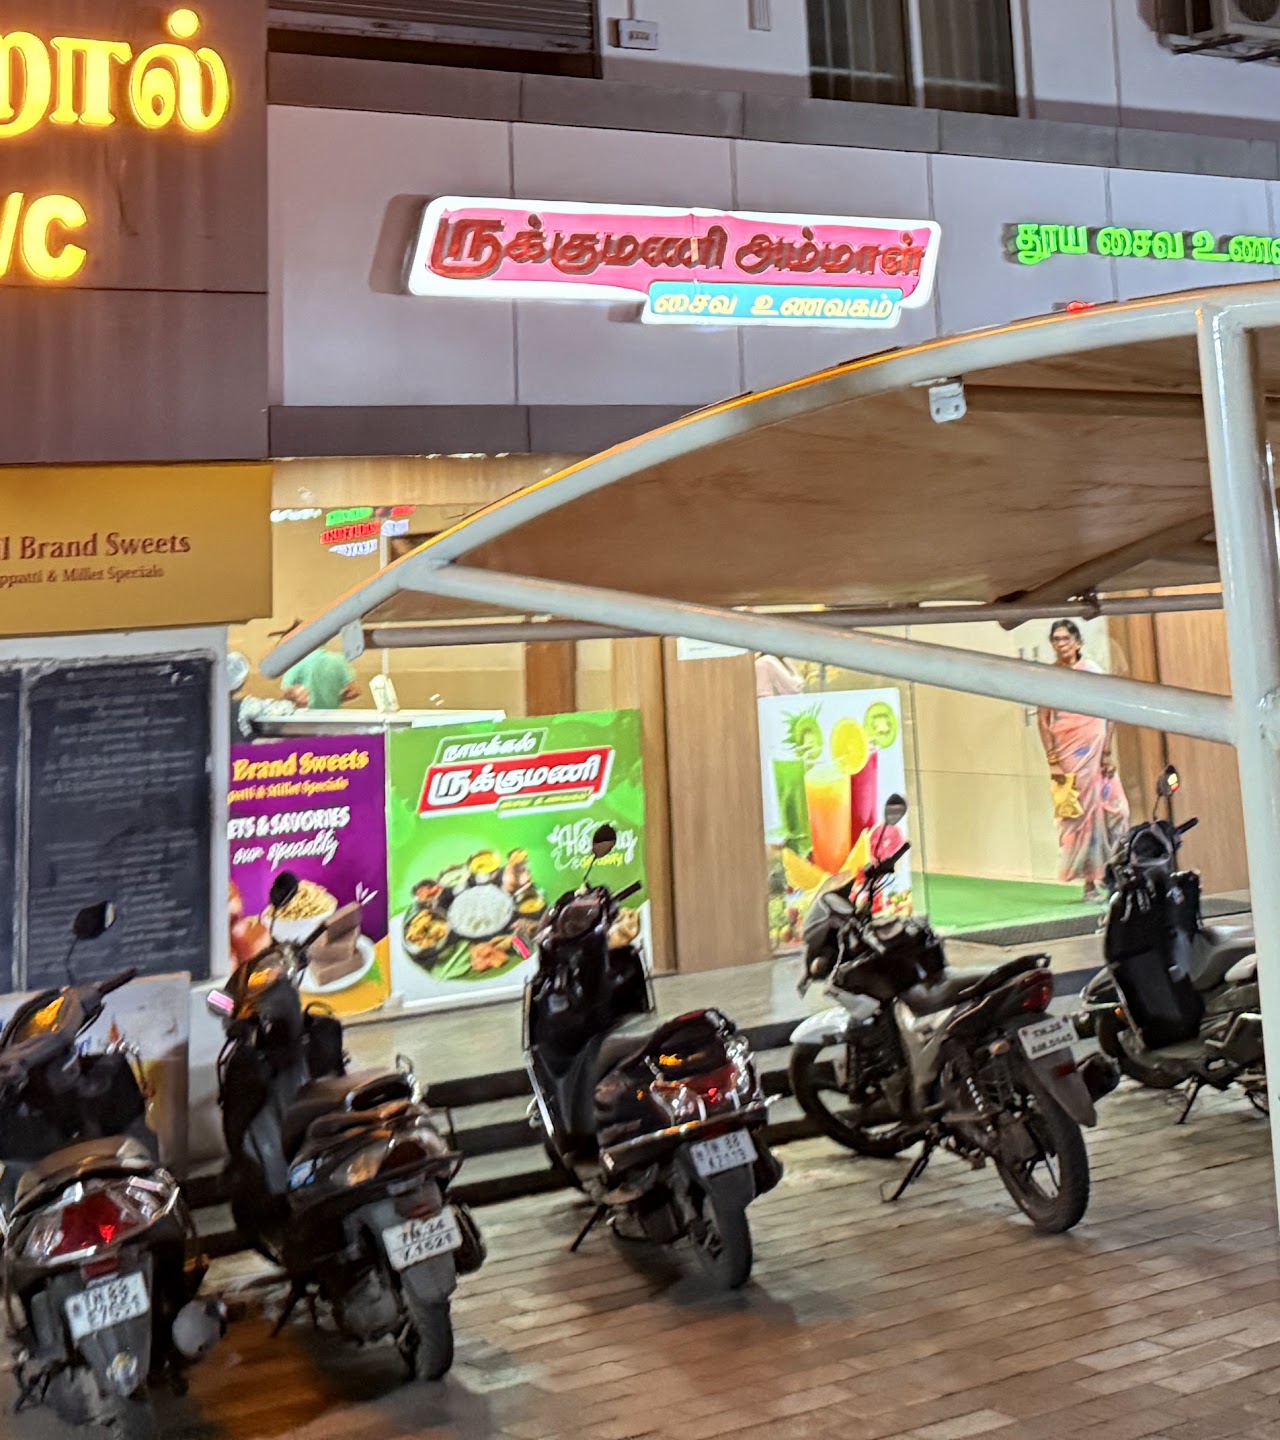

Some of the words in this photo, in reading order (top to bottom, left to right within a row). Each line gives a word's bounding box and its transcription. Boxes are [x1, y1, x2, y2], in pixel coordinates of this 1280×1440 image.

[429, 211, 728, 280] ருக்குமணி
[735, 226, 926, 277] அம்மாள்
[1015, 223, 1088, 265] தூய
[1096, 226, 1185, 260] சைவ
[652, 293, 738, 316] சைவ
[750, 292, 896, 319] உணவகம்
[20, 532, 98, 560] Brand
[105, 531, 192, 557] Sweets
[47, 570, 58, 583] &
[107, 563, 165, 584] Specials
[441, 731, 537, 763] நாமக்கல்
[232, 751, 298, 782] Brand
[298, 748, 370, 775] Sweets
[427, 753, 602, 806] ருக்குமணி
[255, 814, 270, 838] &
[270, 805, 351, 836] SAVORIES
[232, 845, 265, 865] our
